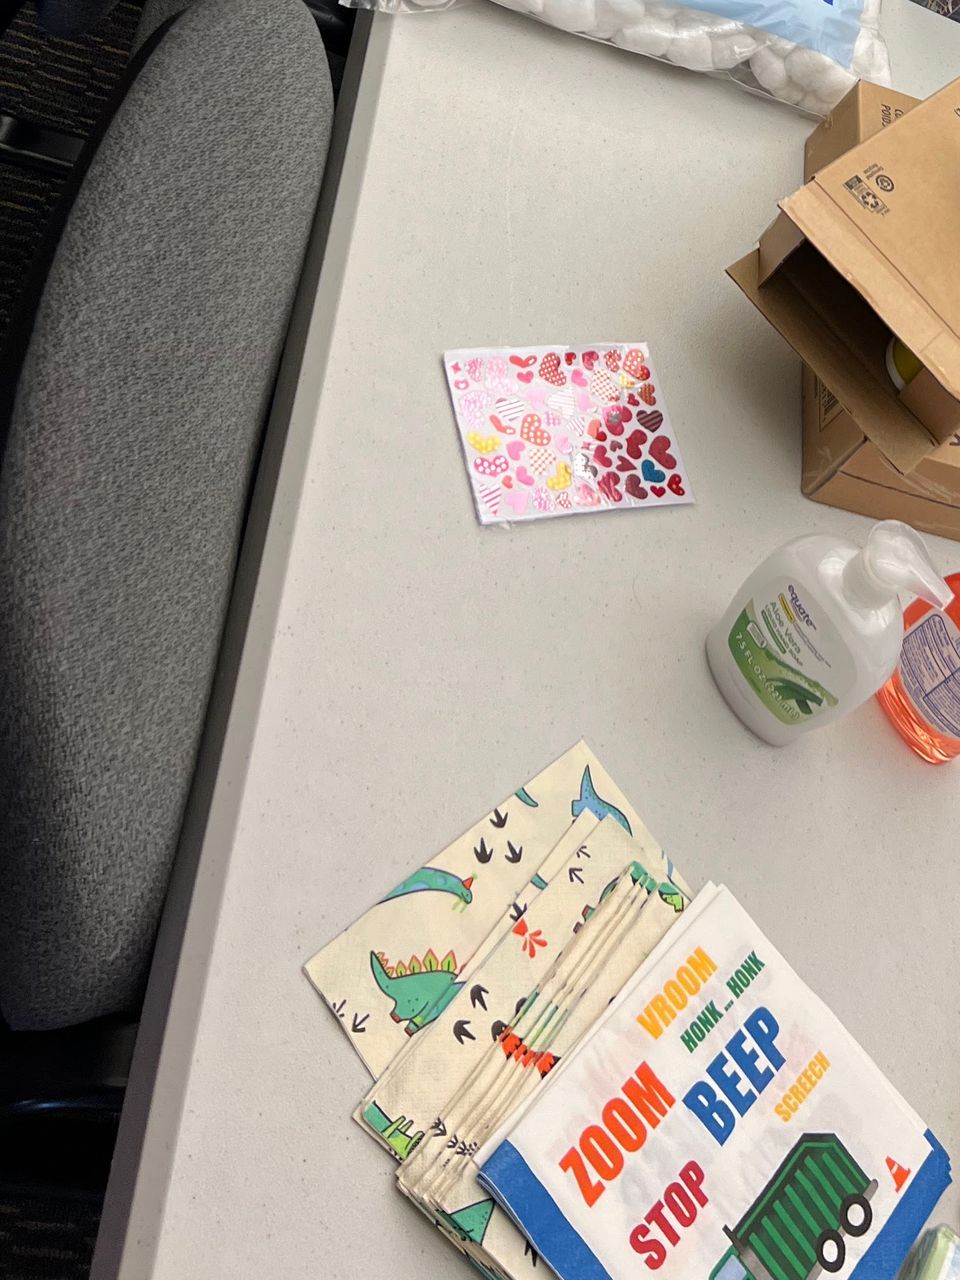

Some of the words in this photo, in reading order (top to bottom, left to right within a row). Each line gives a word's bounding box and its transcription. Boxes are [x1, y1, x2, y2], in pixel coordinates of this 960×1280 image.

[770, 601, 784, 627] Aloe
[785, 628, 801, 654] Vera
[788, 584, 813, 628] equate
[744, 649, 753, 665] FL
[636, 946, 718, 1040] VROOM
[679, 999, 723, 1054] HONK
[725, 950, 766, 998] HONK
[681, 1006, 787, 1147] BEEP
[774, 1050, 832, 1122] SCREECH
[558, 1061, 676, 1208] ZOOM
[629, 1160, 706, 1271] STOP
